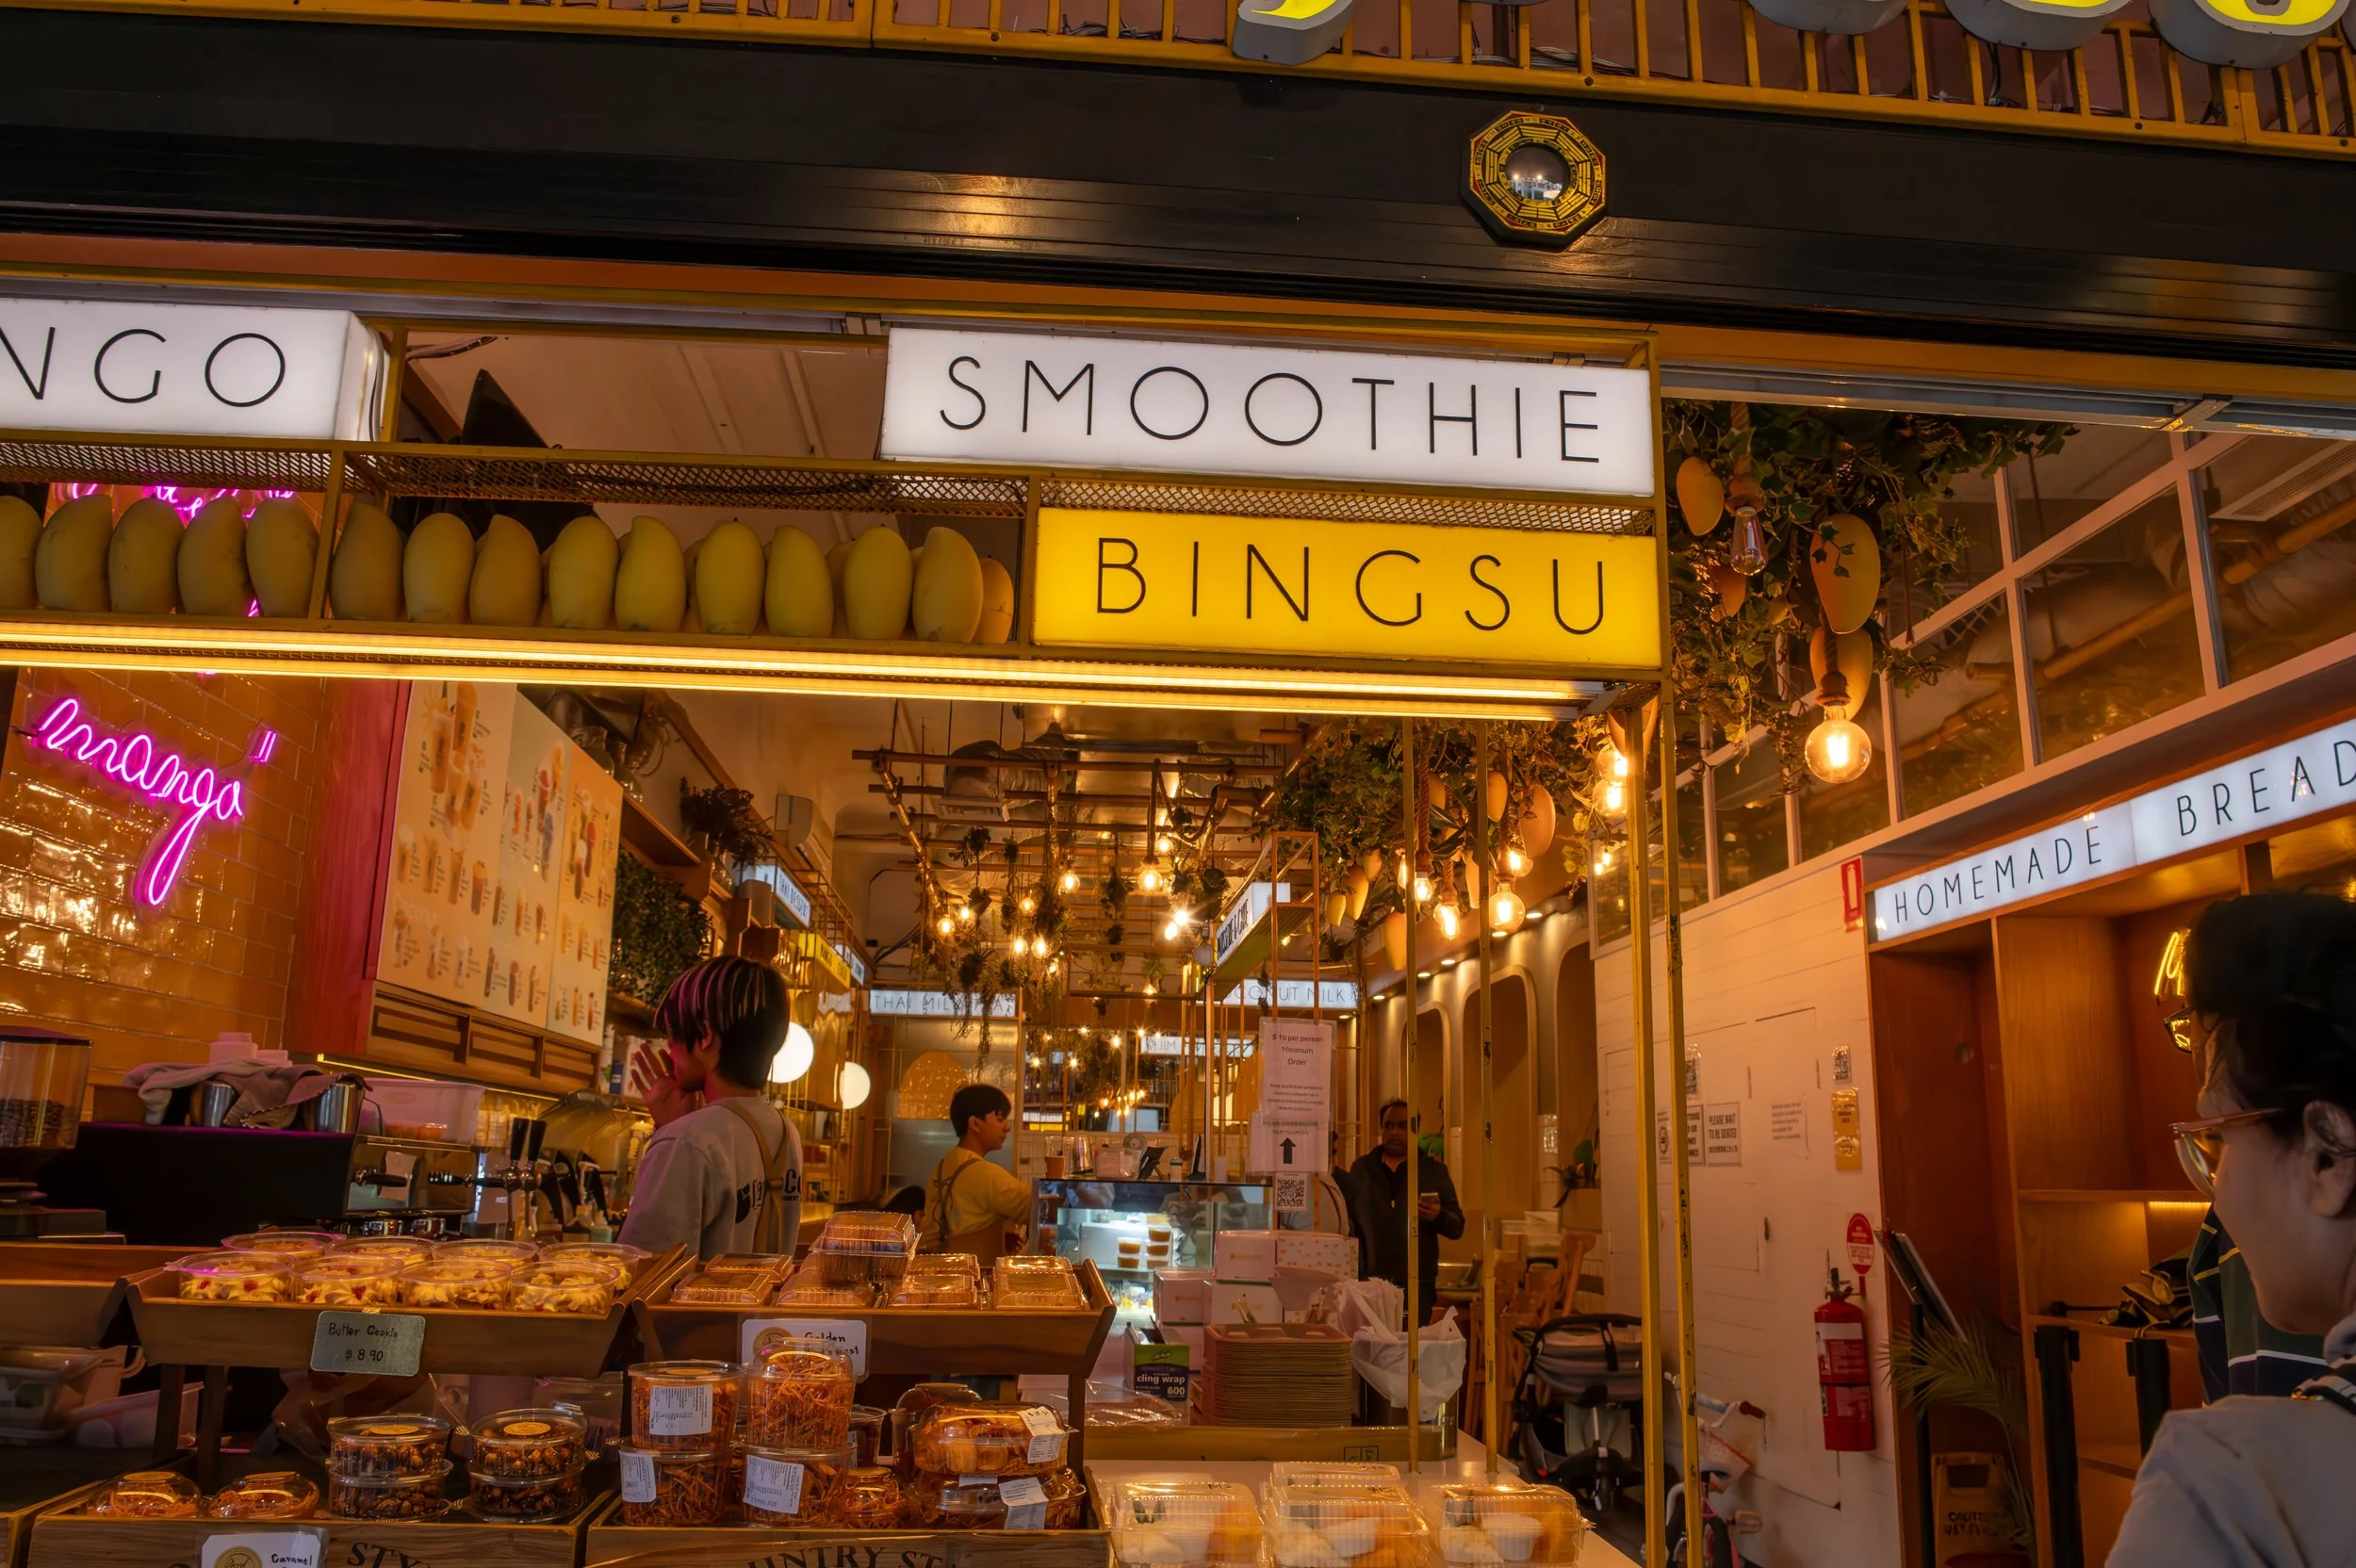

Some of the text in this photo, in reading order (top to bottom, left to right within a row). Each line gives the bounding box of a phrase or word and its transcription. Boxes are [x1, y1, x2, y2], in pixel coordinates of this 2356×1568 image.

[939, 354, 1600, 464] SMOOTHIE
[1096, 536, 1604, 636] BINGSU
[1894, 825, 2102, 923] HOMEMADE
[874, 995, 911, 1009] THAI
[973, 996, 1004, 1011] TA
[1282, 1046, 1314, 1054] Minimum
[1708, 1113, 1737, 1126] PLEASE WAIT
[804, 1331, 846, 1343] Glden
[1137, 1374, 1186, 1385] cling wrap
[1167, 1386, 1186, 1395] 600
[270, 1553, 313, 1566] Caramel
